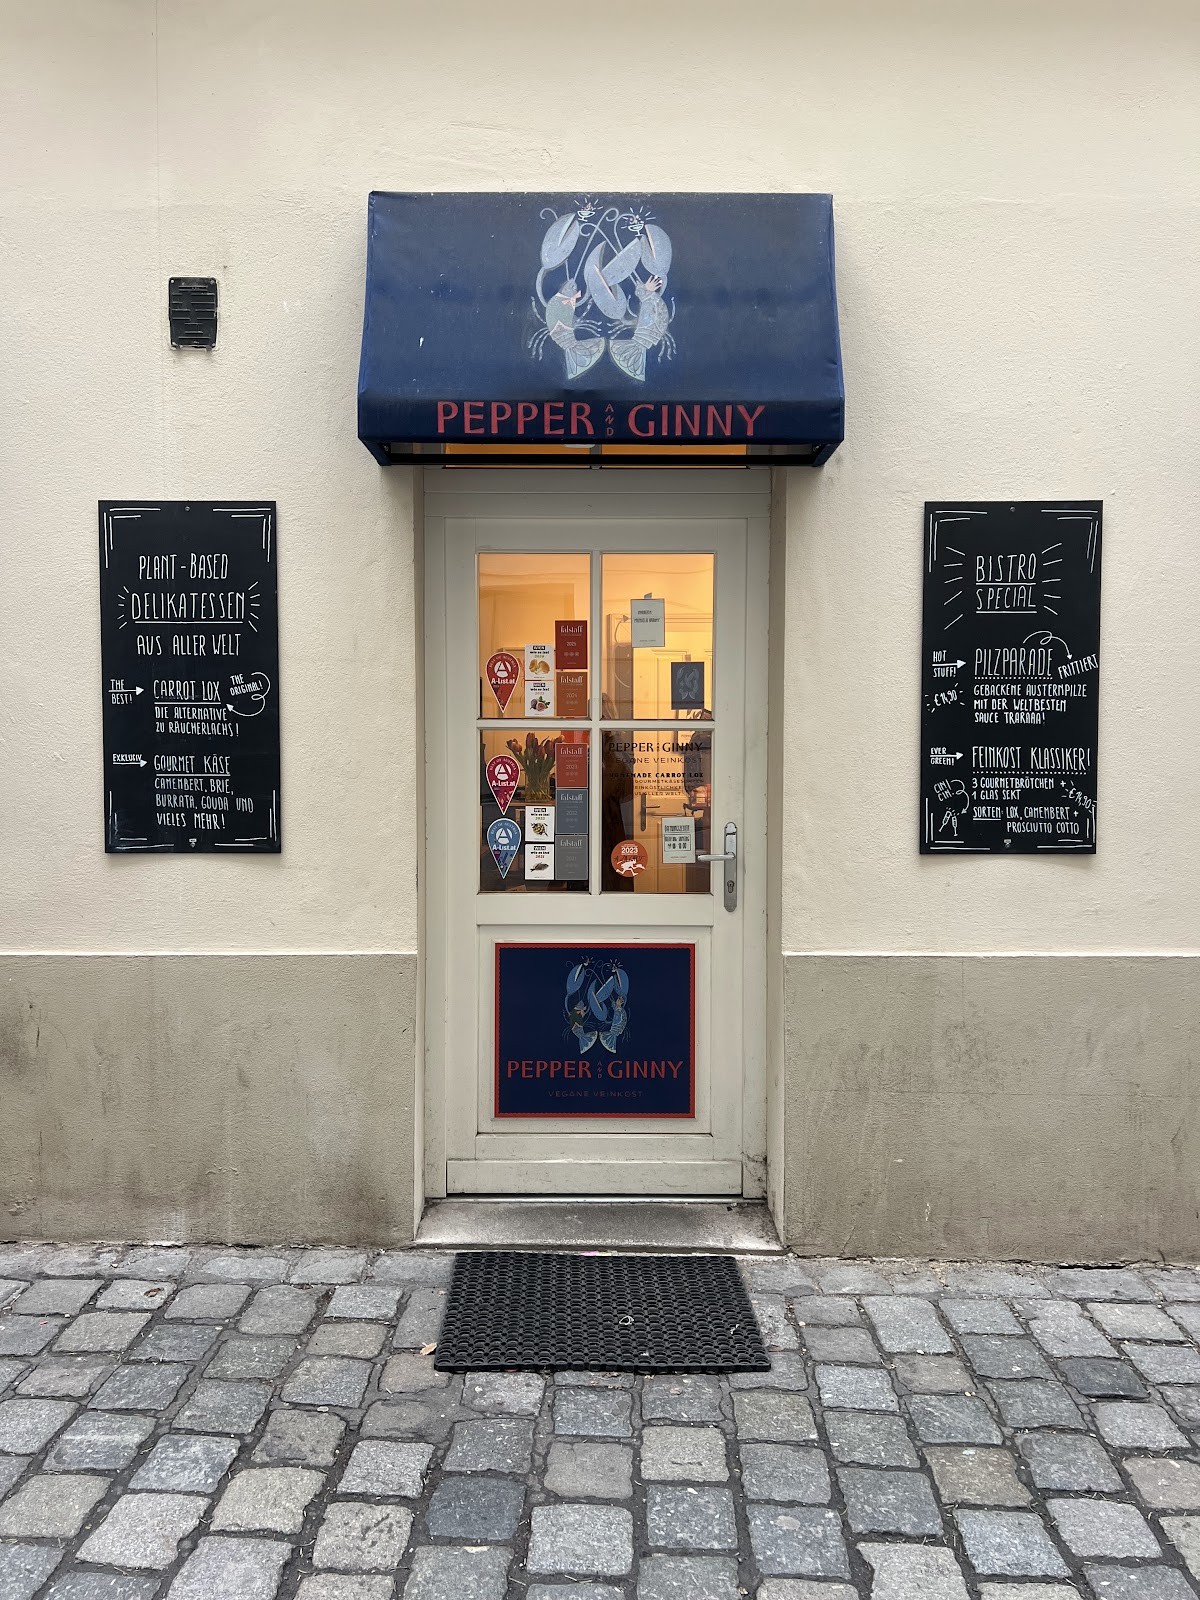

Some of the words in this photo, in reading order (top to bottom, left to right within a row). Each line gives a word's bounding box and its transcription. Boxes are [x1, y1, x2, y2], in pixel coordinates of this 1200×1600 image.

[437, 401, 594, 434] PEPPER
[628, 404, 765, 437] GINNY
[976, 553, 1036, 582] BISTRO
[976, 586, 1036, 610] SPECIAL
[132, 592, 245, 619] DELIKATESSEN
[560, 625, 584, 633] falstaff
[137, 635, 162, 656] AUS
[173, 635, 206, 656] ALLER
[212, 634, 241, 656] WELT
[933, 650, 947, 662] HOT
[975, 648, 1053, 676] PILZPARADE
[933, 668, 956, 677] STUFF!
[1058, 654, 1099, 679] FRITTIERT
[110, 679, 124, 690] THE
[230, 674, 244, 685] THE
[154, 680, 196, 700] CARROT
[202, 681, 221, 701] LOX
[230, 680, 264, 696] ORIGINAL!
[974, 684, 1021, 696] GEBACKENE
[1026, 684, 1087, 697] AUSTERNPILZE
[112, 693, 132, 704] BEST!
[974, 699, 988, 709] MIT
[992, 698, 1008, 710] DER
[155, 707, 168, 719] DIE
[174, 707, 228, 721] ALTERNATIVE
[975, 712, 999, 723] SAUCE
[156, 722, 165, 733] ZU
[609, 743, 653, 752] PEPPER
[662, 743, 702, 752] GINNY
[112, 754, 142, 762] EXKLUSIV
[931, 758, 954, 766] GREEN!
[972, 746, 1021, 768] FEINKOST
[154, 755, 195, 772] GOURMET
[203, 754, 230, 775] KÄSE
[972, 778, 977, 788] 3
[980, 776, 1054, 789] GOURMETBRÖTCHEN
[972, 791, 976, 800] 1
[981, 790, 998, 800] GLAS
[1003, 790, 1021, 800] SEKT
[201, 796, 228, 811] GOUDA
[236, 798, 253, 813] UND
[1024, 807, 1070, 820] CAMEMBERT
[157, 813, 186, 827] VIELES
[194, 813, 225, 829] MEHR!
[1007, 822, 1052, 833] PROSCIUTTO
[1056, 822, 1079, 834] COTTO
[507, 1061, 592, 1078] PEPPER
[608, 1061, 683, 1079] GINNY
